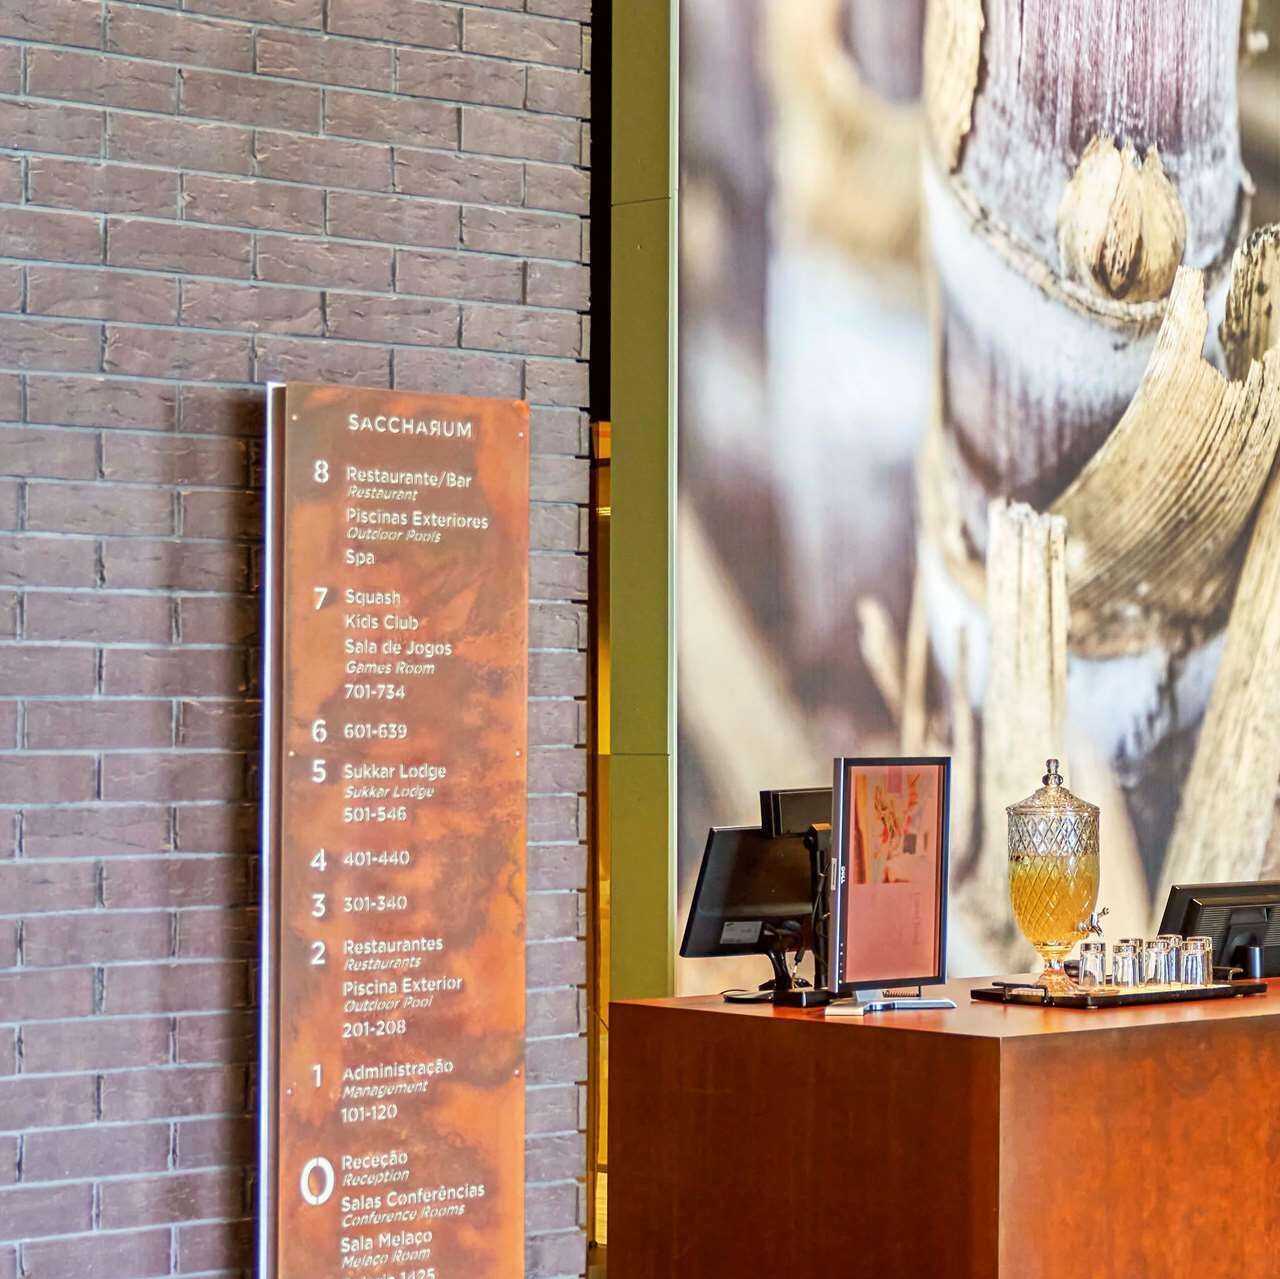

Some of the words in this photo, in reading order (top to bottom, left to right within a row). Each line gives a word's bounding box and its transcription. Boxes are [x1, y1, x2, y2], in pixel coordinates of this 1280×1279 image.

[314, 460, 329, 483] 8
[346, 467, 472, 488] Restaurante/Bar
[348, 486, 418, 501] Restaurant
[346, 509, 408, 525] Piscinas
[413, 511, 489, 529] Exteriores
[347, 528, 402, 540] Outdoor
[406, 530, 441, 542] Pools
[345, 550, 375, 566] Spa
[314, 587, 328, 609] 7
[345, 589, 401, 607] Squash
[345, 615, 378, 629] Kids
[384, 616, 419, 630] Club
[345, 640, 376, 654] Sala
[383, 641, 401, 654] de
[407, 641, 452, 658] Jogos
[345, 662, 392, 674] Games
[396, 662, 434, 675] Room
[345, 685, 405, 699] 701-734
[312, 720, 327, 742] 6
[344, 724, 408, 739] 601-639
[312, 759, 326, 782] 5
[343, 764, 395, 779] Sukkar
[400, 765, 446, 781] Lodge
[344, 786, 390, 798] Sukkar
[393, 786, 435, 798] Lodge
[343, 807, 407, 822] 501-546
[311, 849, 327, 871] 4
[344, 851, 409, 866] 401-440
[311, 894, 326, 917] 3
[343, 897, 408, 913] 301-340
[311, 942, 326, 965] 2
[343, 937, 443, 953] Restaurantes
[344, 957, 422, 970] Restaurants
[343, 979, 398, 996] Piscina
[403, 976, 463, 993] Exterior
[343, 997, 400, 1012] Outdoor
[403, 996, 433, 1008] Pool
[343, 1021, 406, 1039] 201-208
[313, 1064, 321, 1087] 1
[343, 1059, 453, 1081] Administração
[342, 1080, 429, 1100] Management
[342, 1106, 398, 1123] 101-120
[342, 1150, 408, 1170] Receção
[342, 1168, 410, 1188] Reception
[341, 1195, 382, 1213] Salas
[387, 1184, 485, 1208] Conferências
[342, 1208, 418, 1228] Conference
[421, 1203, 465, 1218] Rooms
[341, 1236, 373, 1253] Sala
[379, 1229, 433, 1250] Melaço
[393, 1246, 431, 1262] Room
